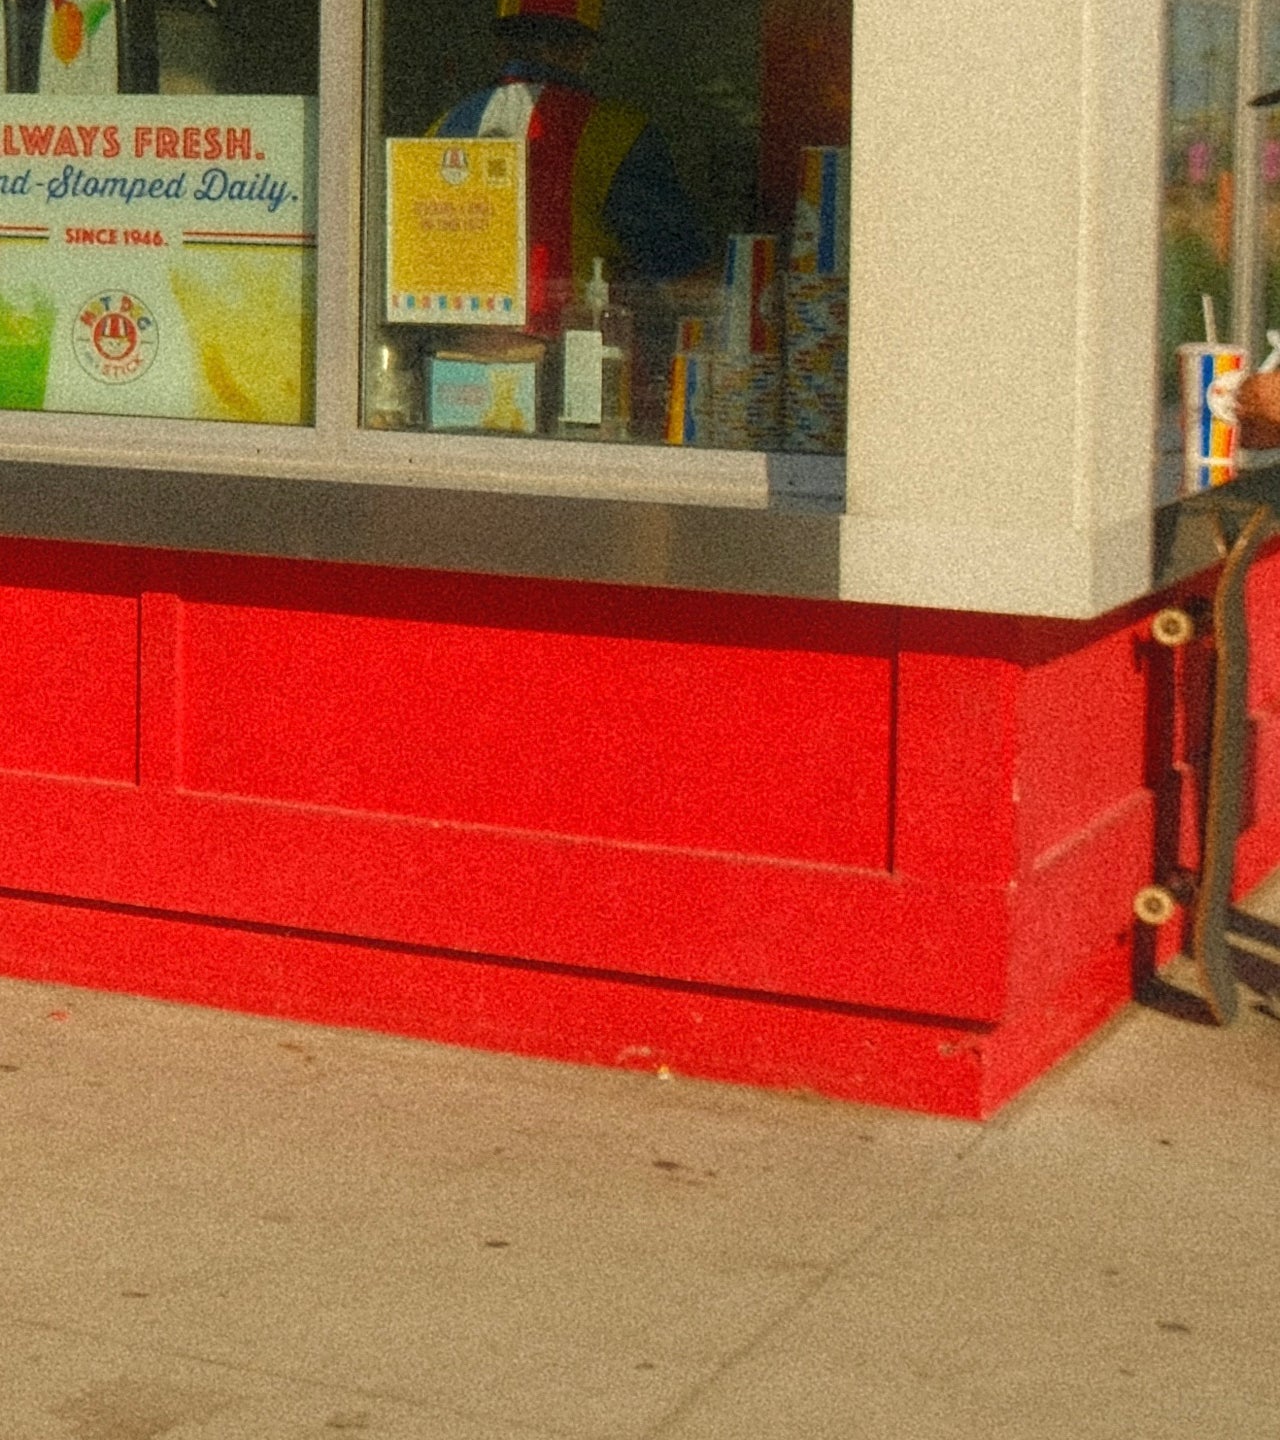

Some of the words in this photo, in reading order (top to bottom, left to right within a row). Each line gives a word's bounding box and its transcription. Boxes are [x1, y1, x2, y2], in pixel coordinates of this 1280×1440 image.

[133, 126, 266, 161] FRESH.
[192, 167, 300, 213] Daily.
[65, 227, 118, 245] SINCE
